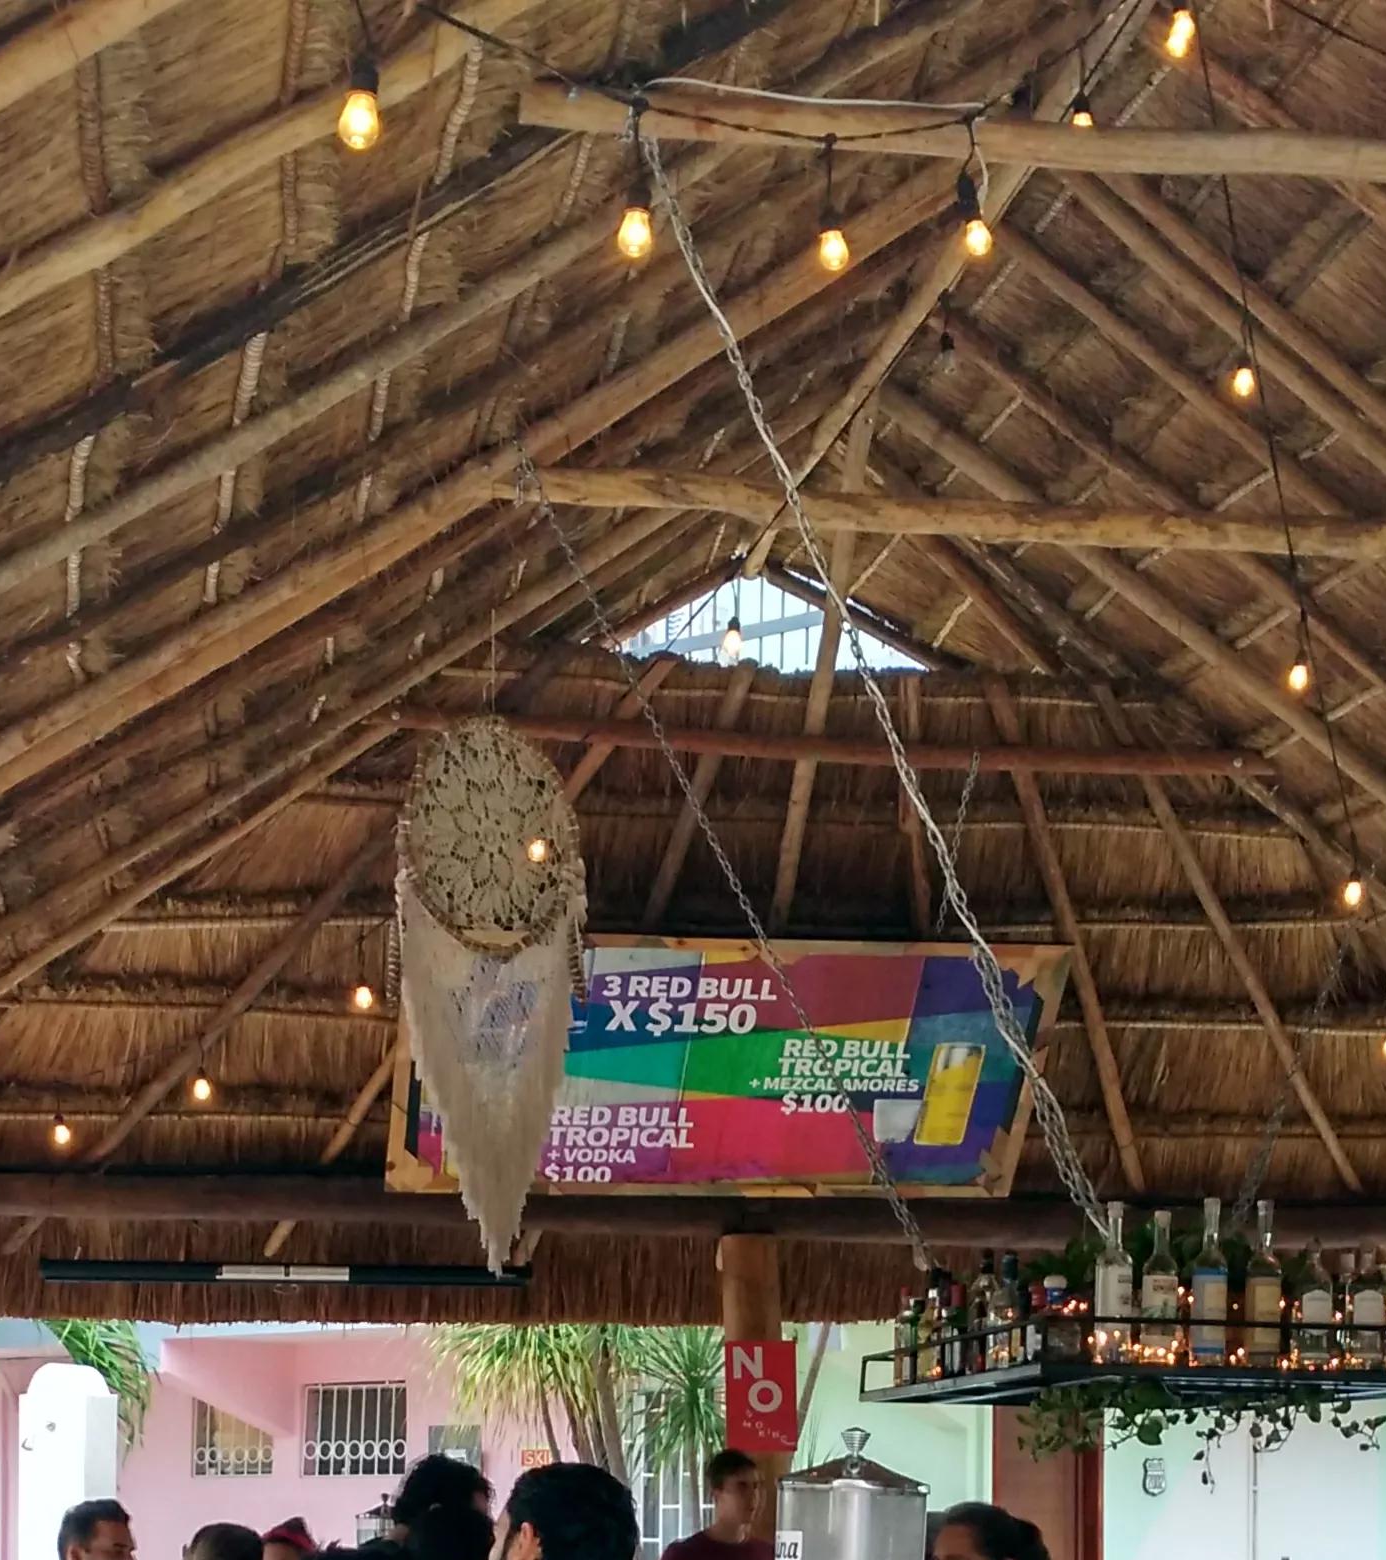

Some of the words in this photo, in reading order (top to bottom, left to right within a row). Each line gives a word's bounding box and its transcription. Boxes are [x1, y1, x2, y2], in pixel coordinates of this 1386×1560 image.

[602, 975, 620, 997] 3
[628, 976, 691, 998] RED
[698, 978, 777, 1000] BULL
[605, 1000, 639, 1031] X
[645, 996, 757, 1036] $150
[783, 1039, 838, 1058] RED
[842, 1040, 910, 1059] BULL
[778, 1057, 908, 1077] TROPICAL
[763, 1077, 837, 1090] MEZCAL
[843, 1079, 919, 1092] AMORES
[780, 1090, 850, 1115] $100
[551, 1105, 612, 1126] RED
[617, 1106, 694, 1128] BULL
[550, 1126, 694, 1148] TROPICAL
[563, 1149, 636, 1163] VODKA
[544, 1163, 612, 1183] $100
[732, 1346, 783, 1413] NO
